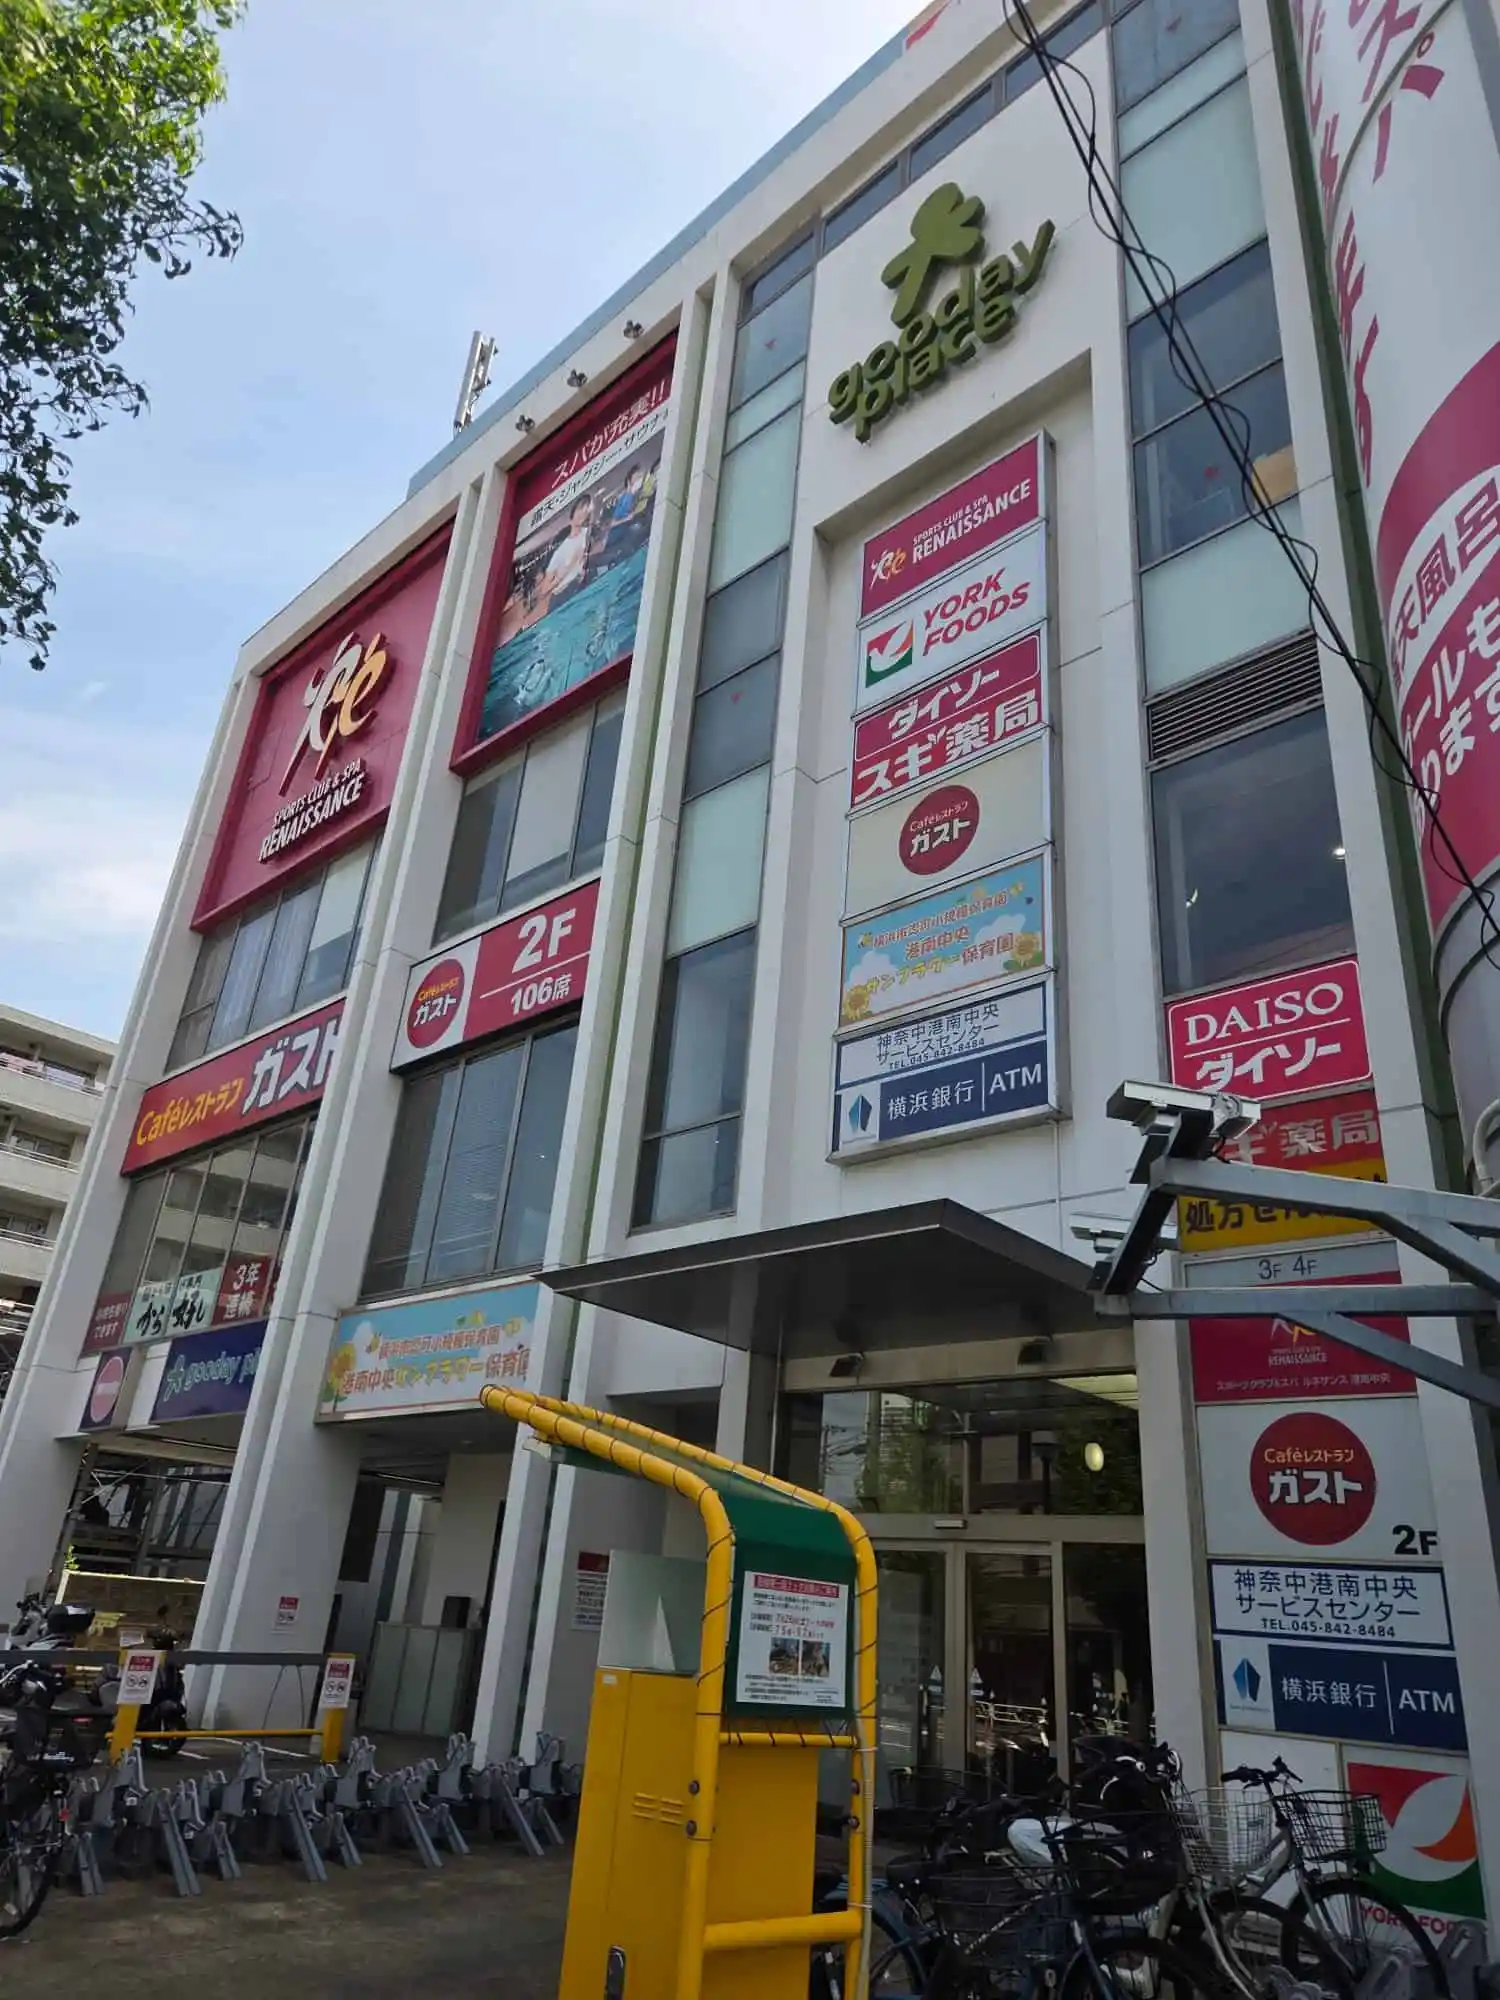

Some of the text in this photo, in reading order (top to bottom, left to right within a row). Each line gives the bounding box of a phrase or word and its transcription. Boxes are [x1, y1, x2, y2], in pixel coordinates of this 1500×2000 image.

[856, 297, 1016, 443] place
[912, 478, 1031, 564] RENAISSANCE
[913, 521, 943, 545] SPORTS
[944, 508, 964, 527] CLUB
[973, 494, 989, 508] SPA
[922, 581, 1030, 656] FOODS
[923, 567, 1006, 629] YORK
[888, 669, 1000, 740] ダイソー
[854, 688, 1038, 804] スギ薬局
[258, 772, 364, 862] RENAISSANCE
[909, 818, 971, 857] ガスト
[512, 908, 576, 974] 2F
[413, 994, 457, 1027] ガスト
[511, 973, 572, 1015] 106席
[1184, 982, 1344, 1046] DAISO
[876, 1024, 1000, 1066] サービスセンター
[877, 1001, 1000, 1049] 神奈中港南中央
[1196, 1036, 1341, 1092] ダイソー
[887, 1063, 1042, 1121] 横浜銀行 ATM
[1257, 1255, 1318, 1280] 3F 4F
[1268, 1468, 1363, 1505] ガスト
[1391, 1524, 1438, 1556] 2F
[1233, 1568, 1419, 1600] 神奈中港南中央
[1236, 1594, 1421, 1624] サービスセンター
[1260, 1617, 1397, 1639] TEL.045-842-8484
[1281, 1676, 1456, 1714] 横浜銀行 ATM
